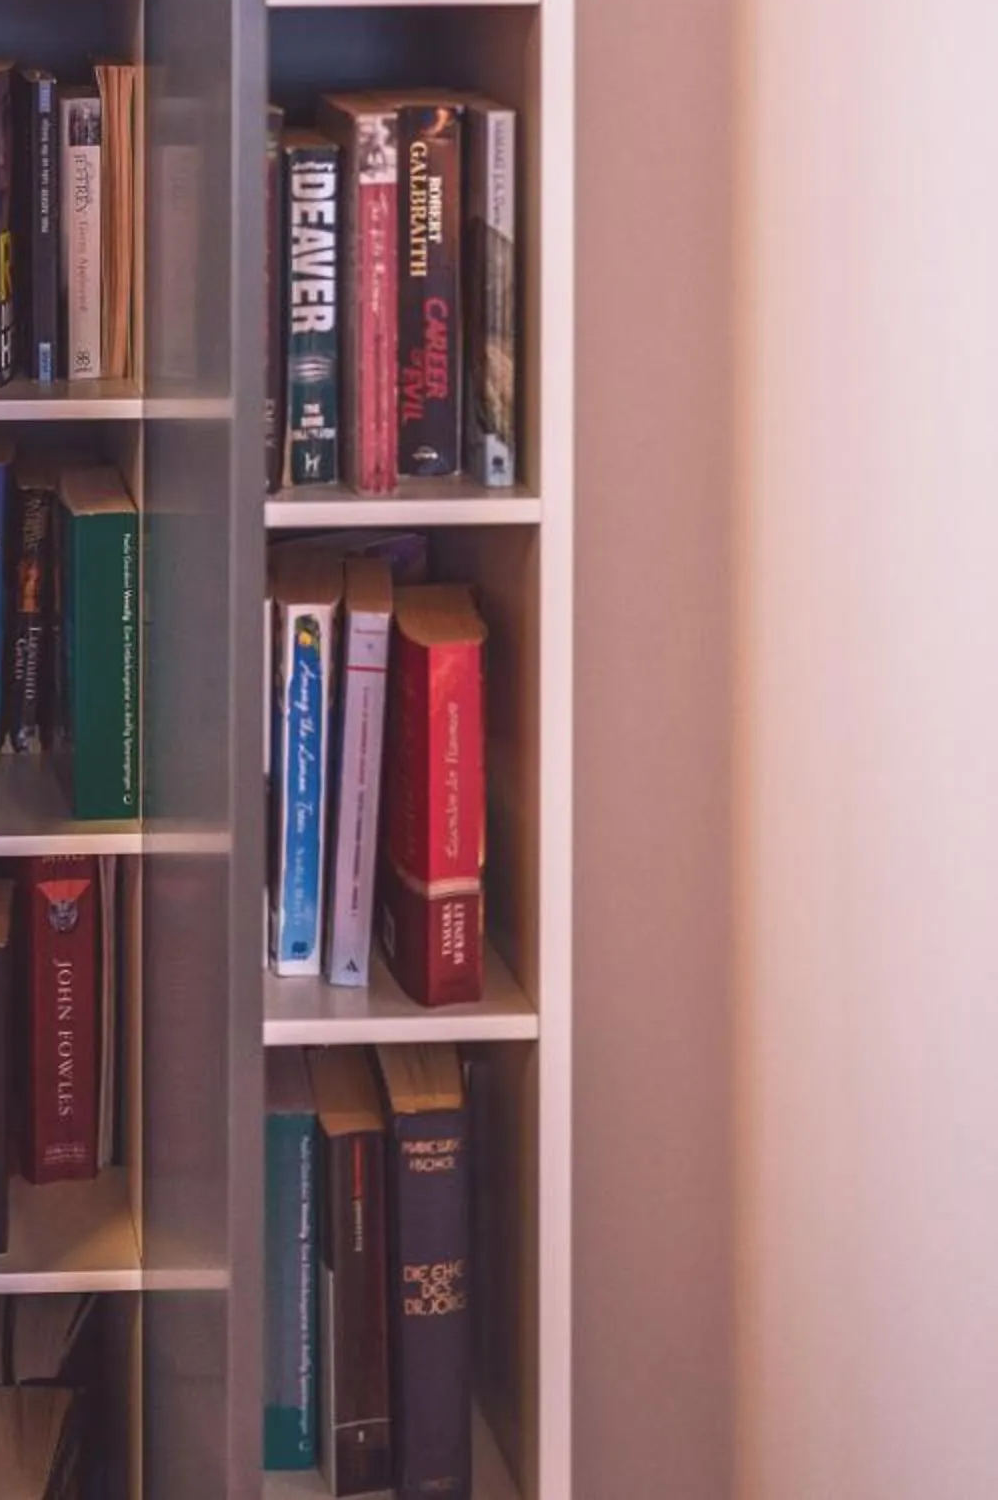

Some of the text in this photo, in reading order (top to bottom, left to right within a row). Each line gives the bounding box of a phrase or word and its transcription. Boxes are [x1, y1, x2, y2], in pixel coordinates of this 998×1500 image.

[292, 175, 336, 334] DEAVER
[409, 141, 427, 277] GALBRAITH
[428, 176, 442, 243] ROBERT
[402, 366, 423, 424] EVIL
[426, 297, 447, 400] CAREER
[53, 959, 74, 1117] JOHN FOWLES
